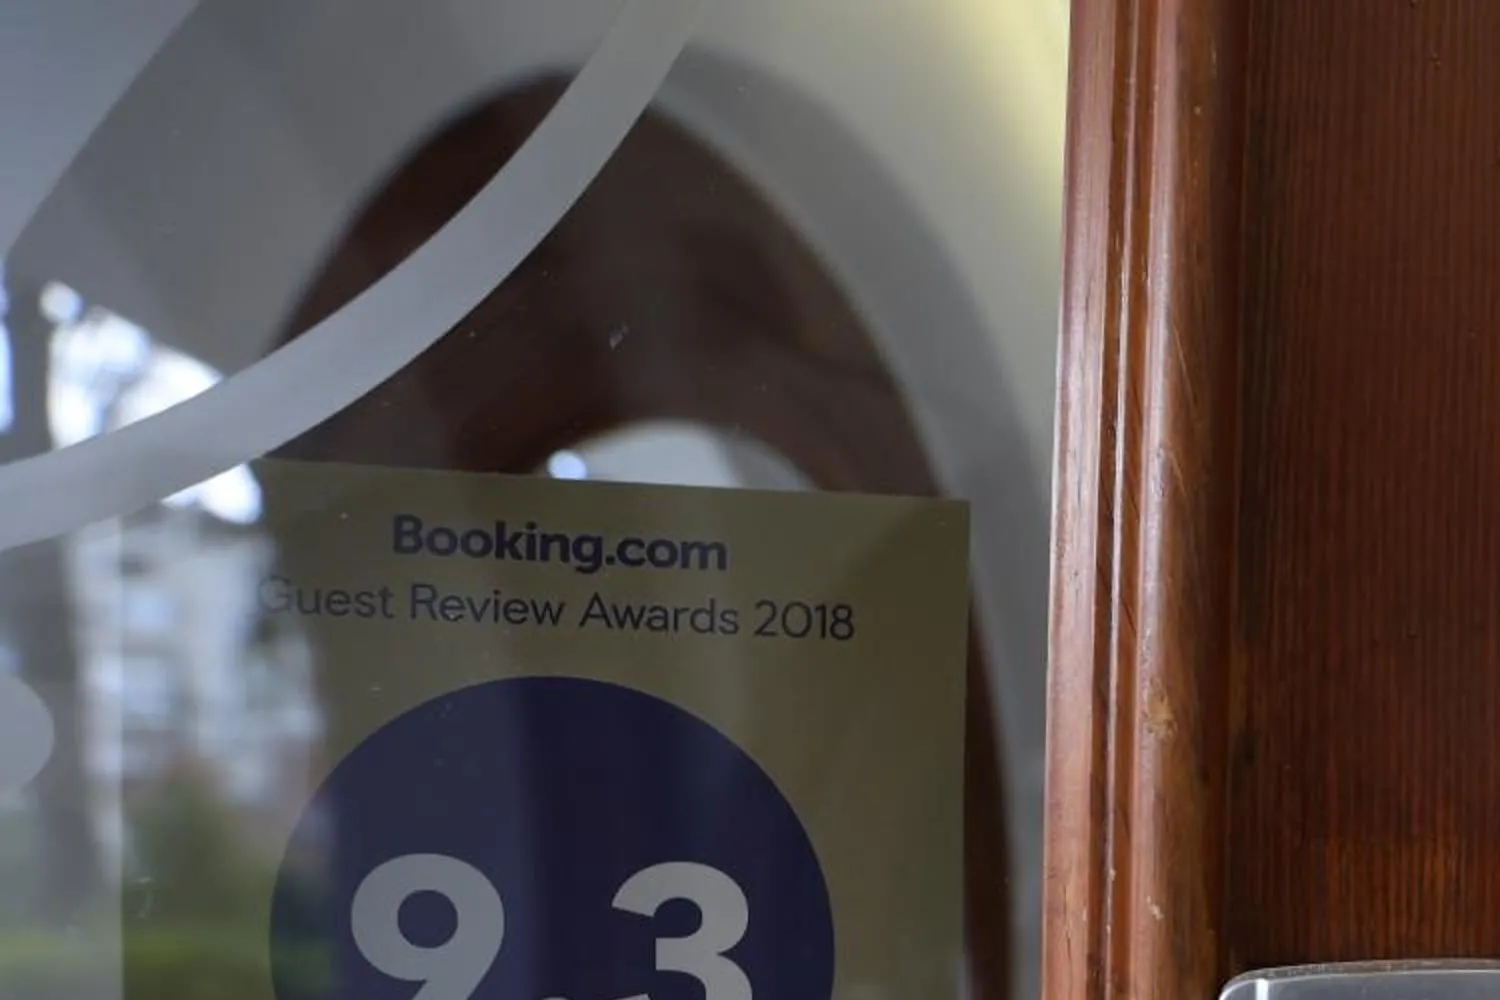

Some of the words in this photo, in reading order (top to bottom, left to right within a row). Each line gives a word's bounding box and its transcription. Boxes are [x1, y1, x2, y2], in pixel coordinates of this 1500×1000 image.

[392, 513, 728, 575] Booking.com
[408, 583, 567, 629] Review
[579, 590, 740, 637] Awards
[753, 600, 856, 641] 2018
